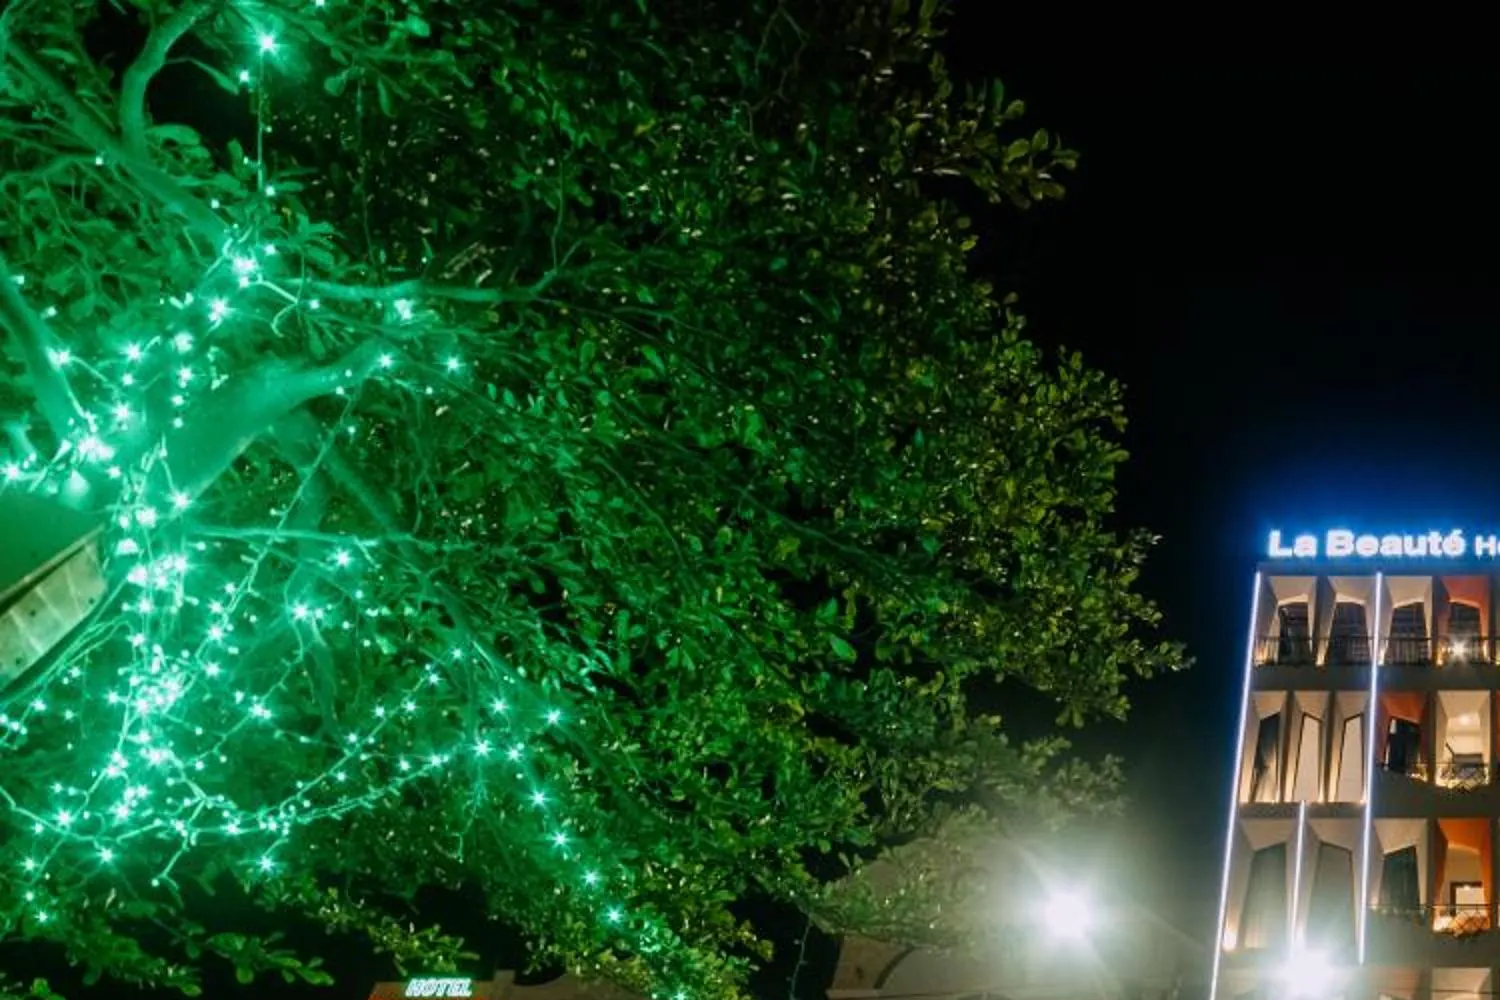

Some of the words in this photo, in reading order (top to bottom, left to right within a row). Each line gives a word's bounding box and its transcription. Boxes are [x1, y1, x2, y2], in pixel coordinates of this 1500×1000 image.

[1267, 529, 1317, 557] La
[1326, 526, 1466, 557] Beauté
[405, 978, 472, 998] HOTEL
